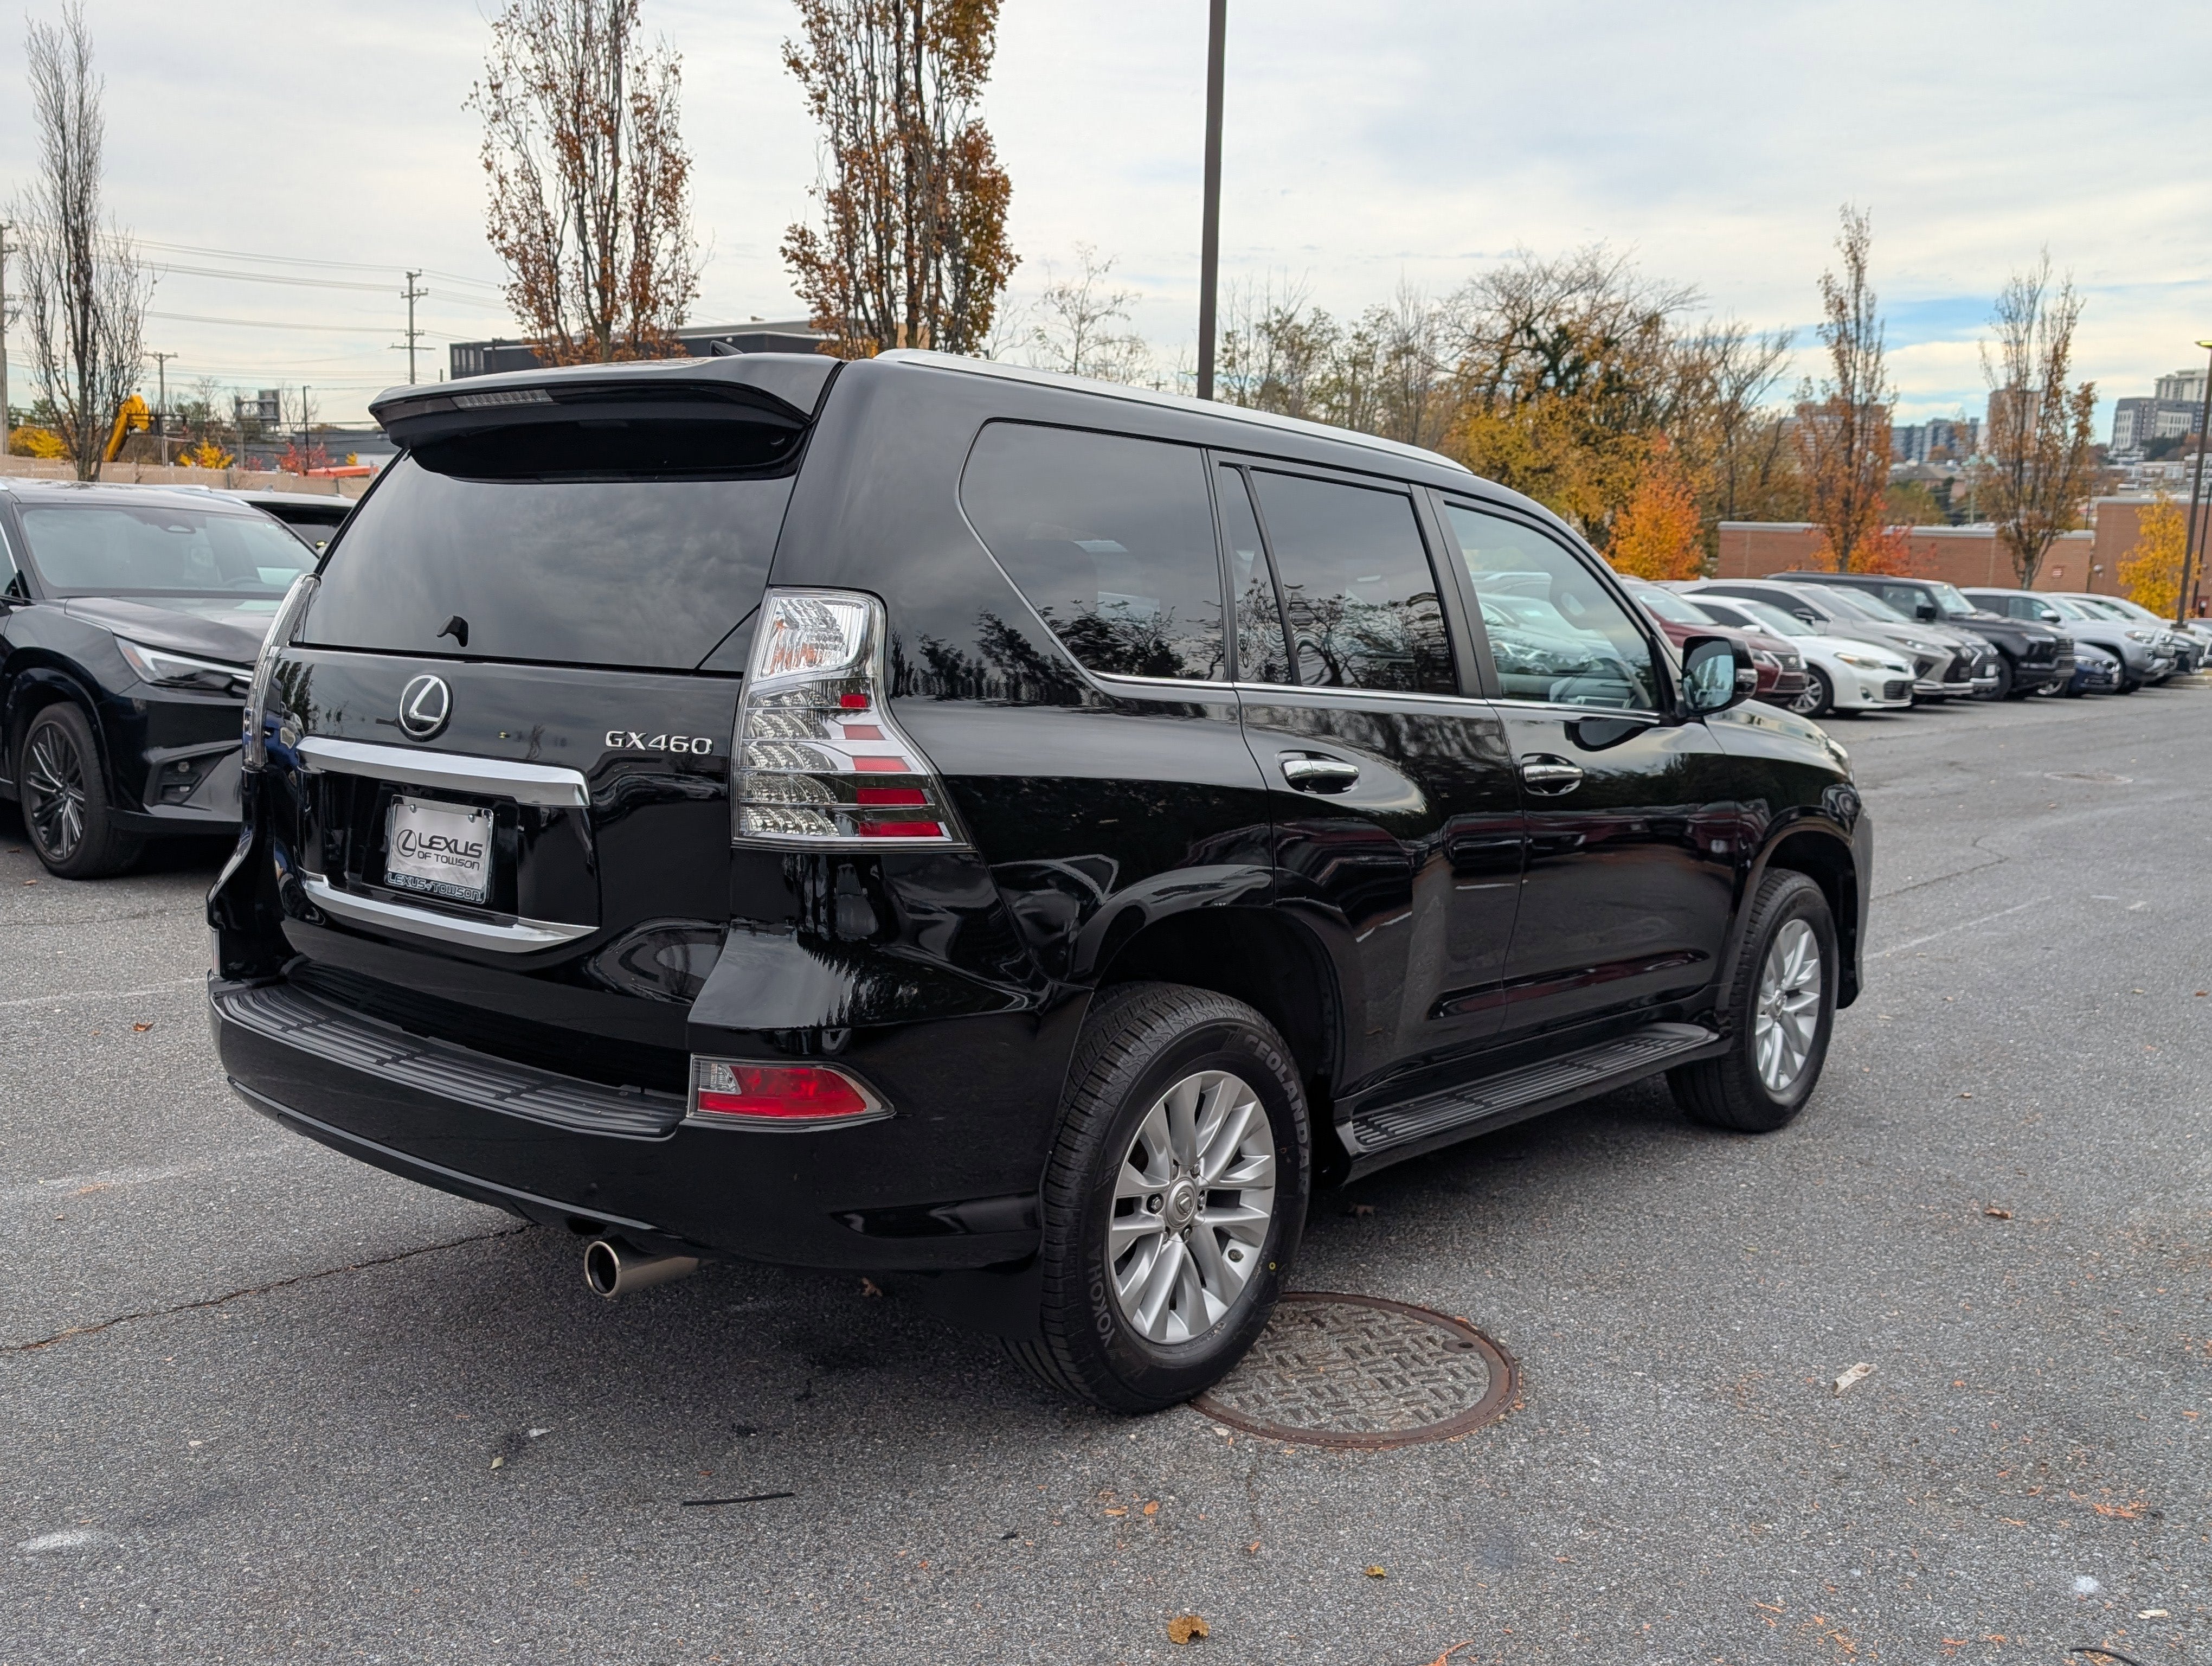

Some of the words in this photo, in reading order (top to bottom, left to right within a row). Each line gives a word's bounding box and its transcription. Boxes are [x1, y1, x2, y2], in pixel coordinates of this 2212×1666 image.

[606, 731, 713, 755] GX460
[419, 832, 483, 858] LEXUS
[417, 851, 432, 860] OF
[434, 854, 480, 871] TOWSON
[388, 872, 426, 890] LEXUS
[432, 882, 482, 901] TOWSON
[1088, 1242, 1115, 1348] YOKOHA
